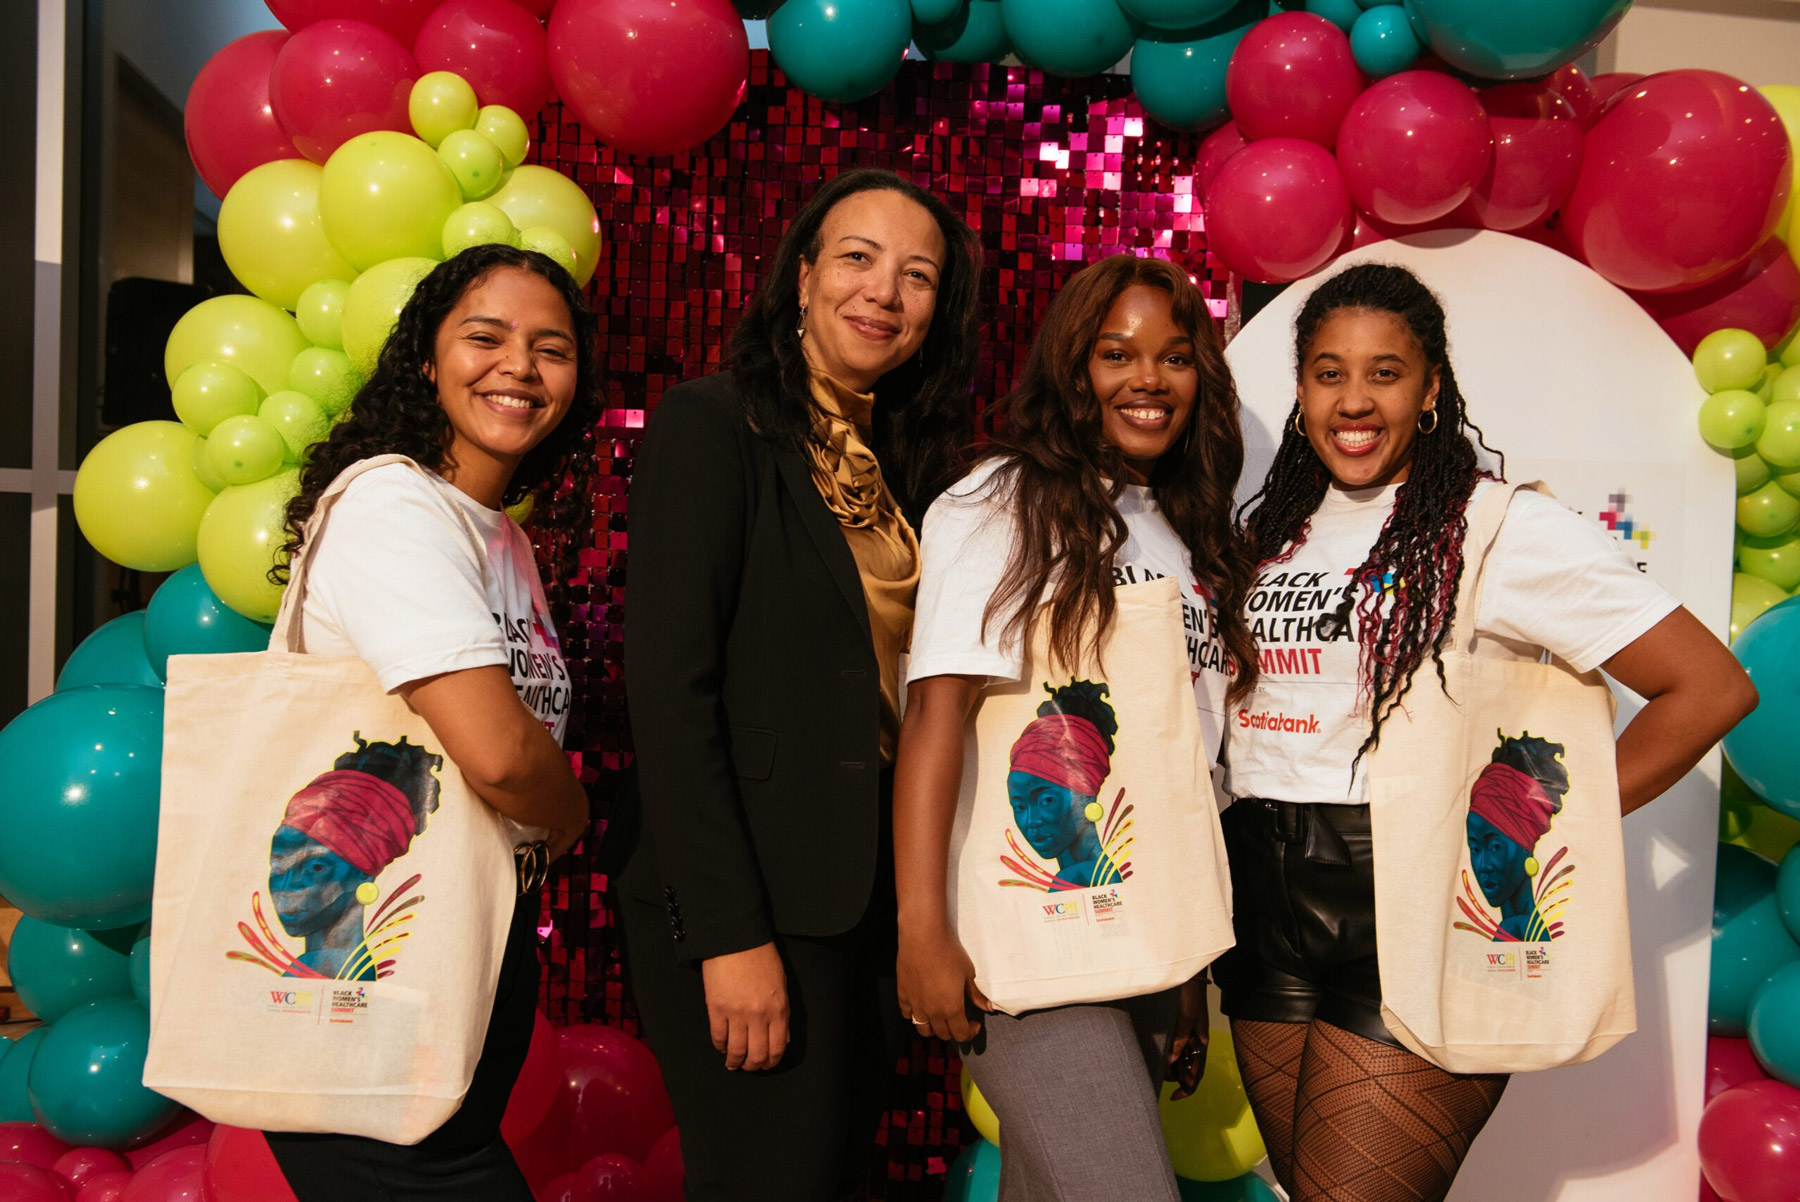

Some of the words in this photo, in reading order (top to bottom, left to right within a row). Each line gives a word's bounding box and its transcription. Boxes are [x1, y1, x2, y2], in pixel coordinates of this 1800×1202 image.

[1112, 566, 1166, 587] BLA
[1255, 572, 1330, 588] LACK
[1246, 587, 1358, 612] OMEN'
[1229, 648, 1322, 675] MMIT
[1238, 708, 1320, 734] Scotiabank
